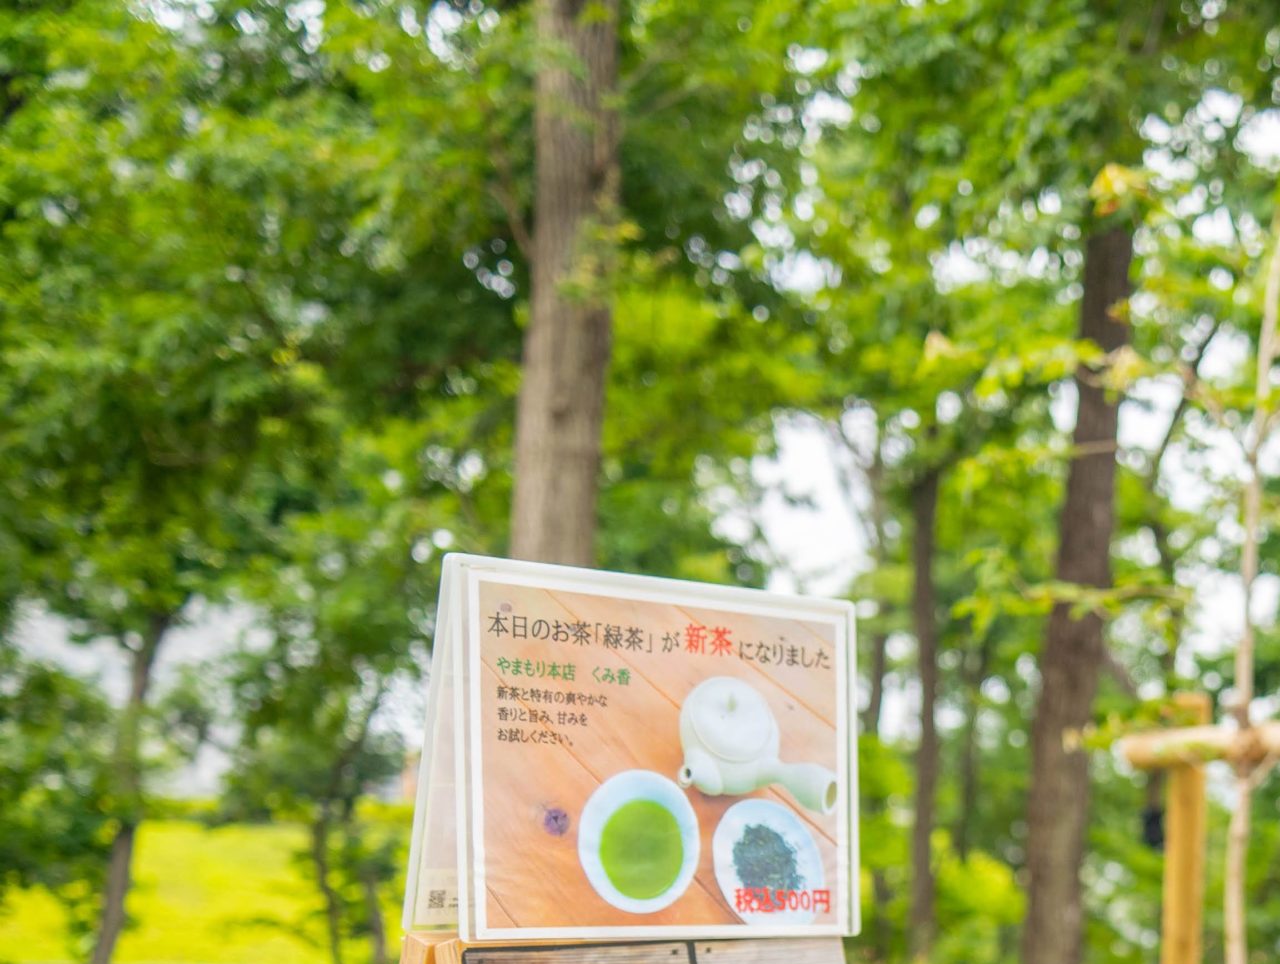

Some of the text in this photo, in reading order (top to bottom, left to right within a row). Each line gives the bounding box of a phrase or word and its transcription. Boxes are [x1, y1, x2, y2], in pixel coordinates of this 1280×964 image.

[496, 657, 631, 686] やまもり本店 くみ香
[735, 886, 831, 914] 税込500円
